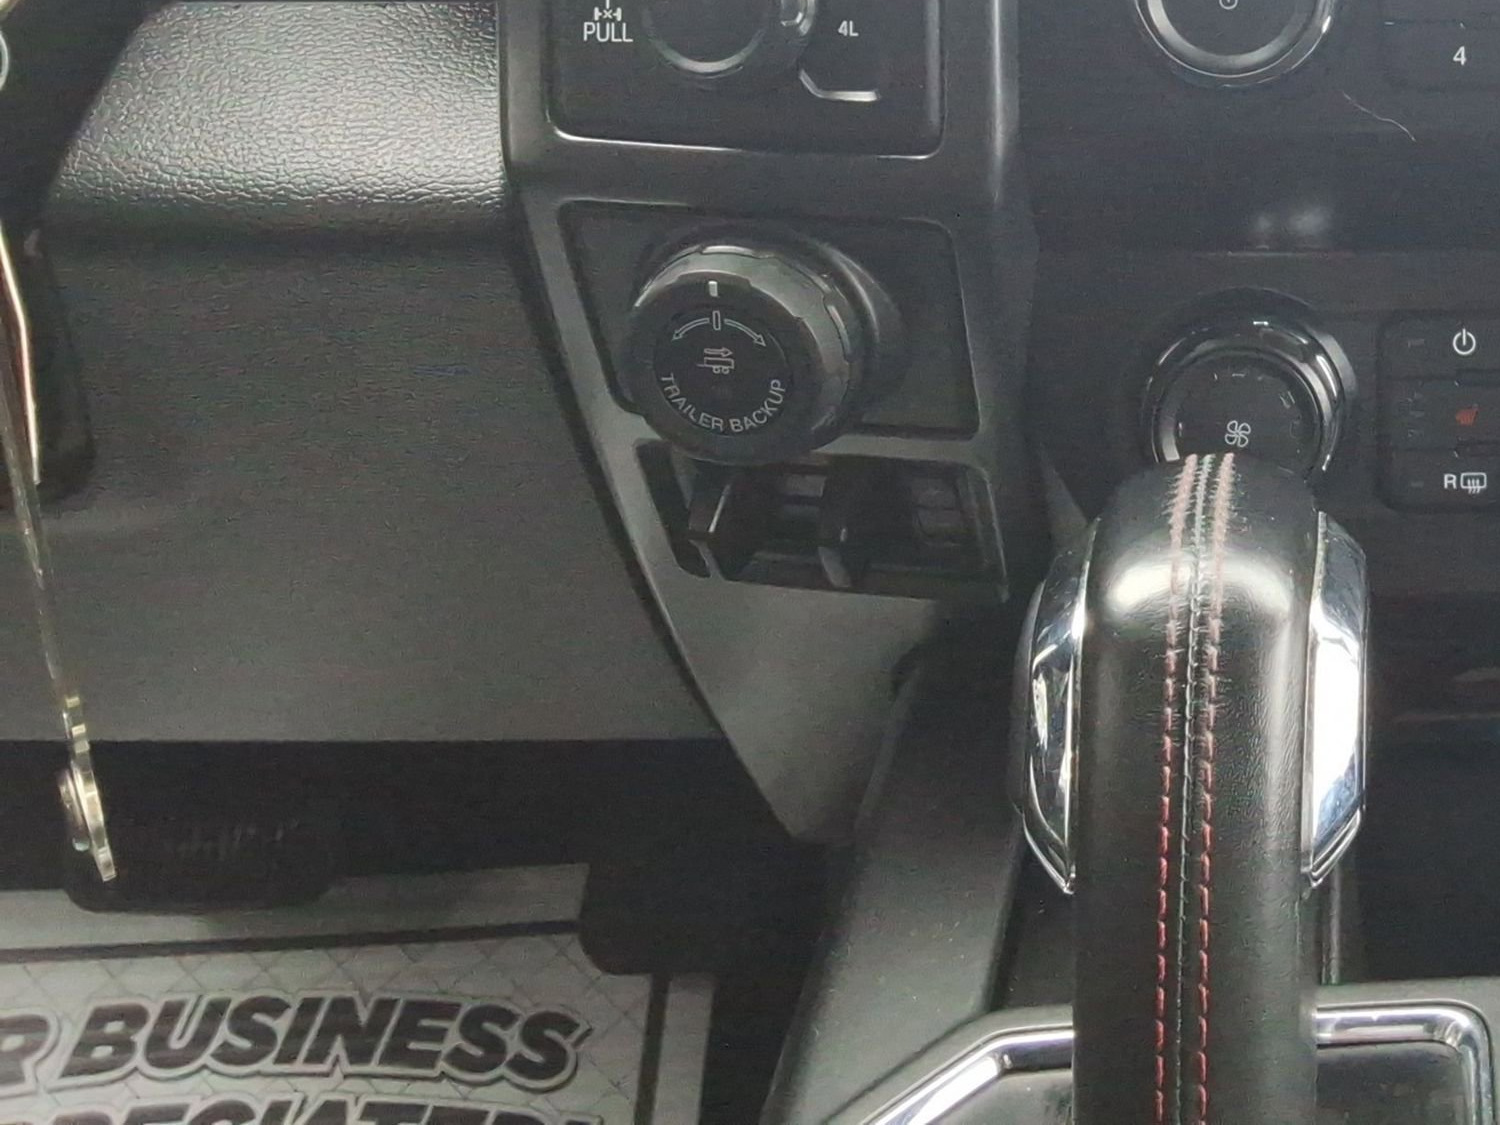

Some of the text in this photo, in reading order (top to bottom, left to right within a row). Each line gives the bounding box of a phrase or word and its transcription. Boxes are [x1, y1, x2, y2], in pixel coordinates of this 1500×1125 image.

[583, 21, 633, 43] PULL
[838, 20, 859, 37] 4L
[1453, 46, 1466, 65] 4
[661, 373, 786, 433] TRAILER BACKUP
[1444, 474, 1457, 489] R
[54, 993, 585, 1083] BUSINESS
